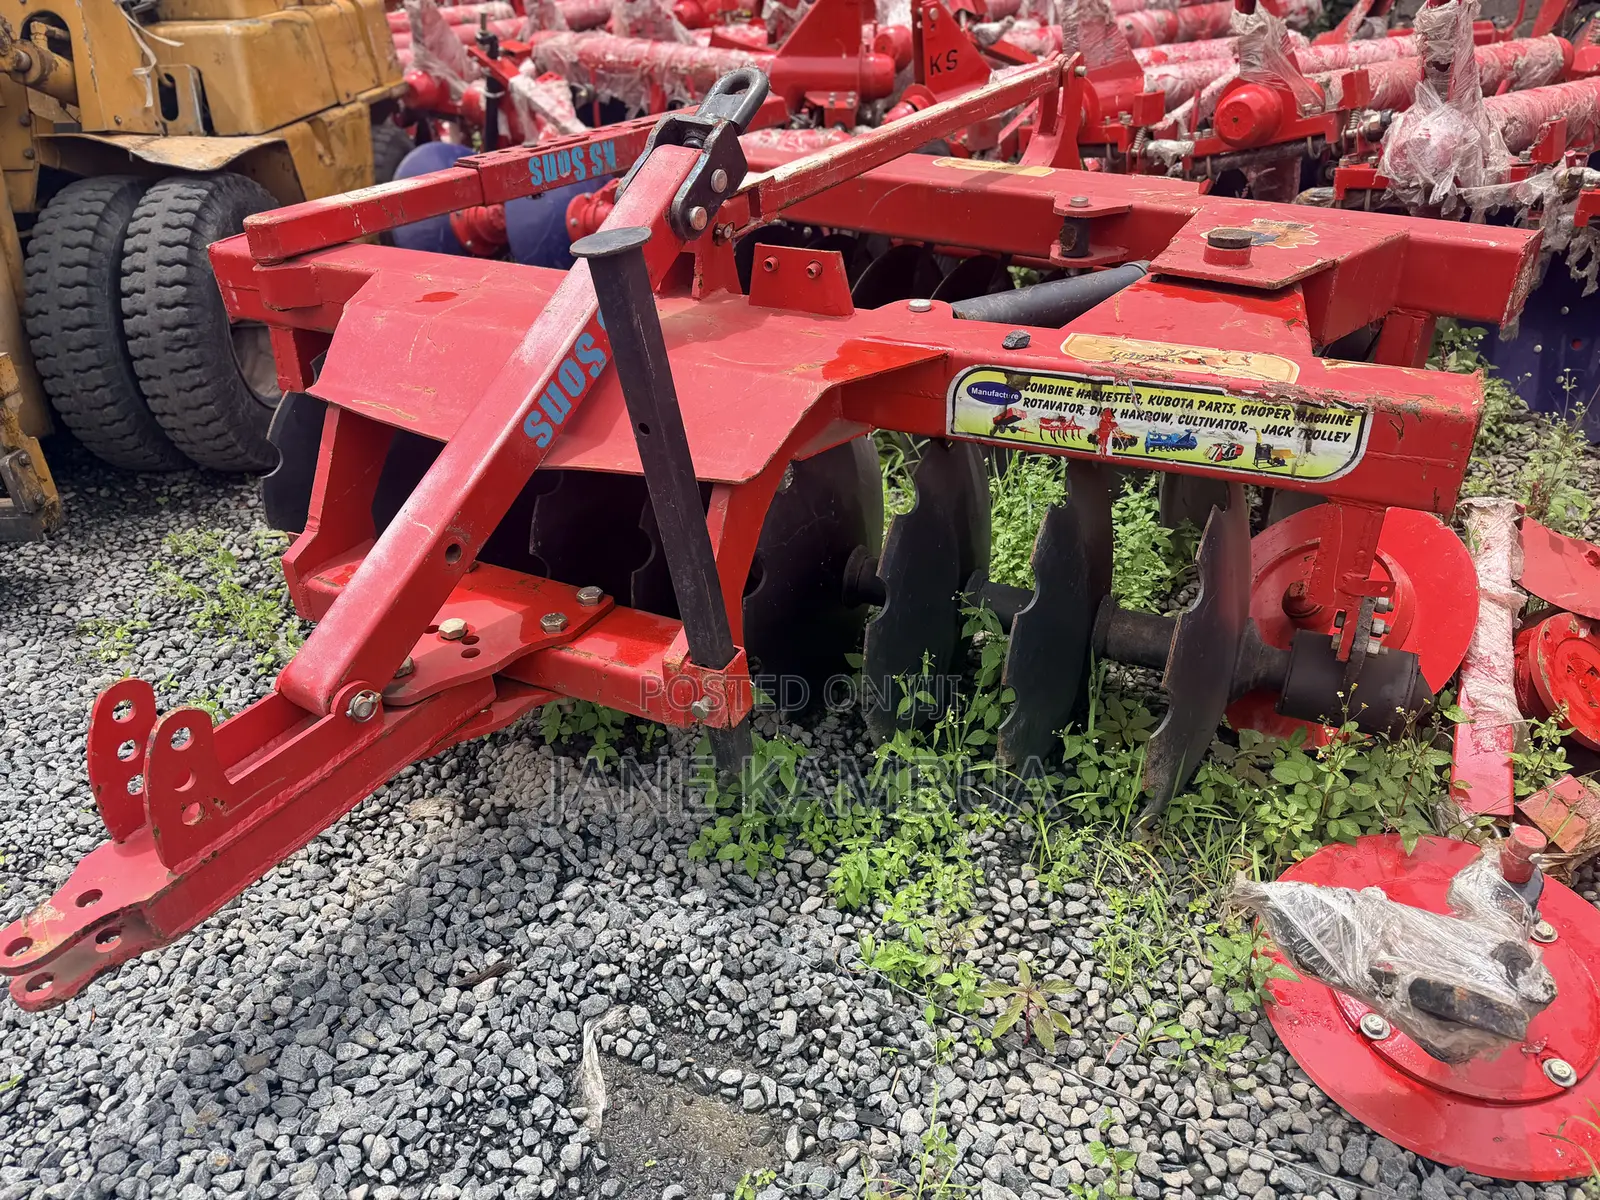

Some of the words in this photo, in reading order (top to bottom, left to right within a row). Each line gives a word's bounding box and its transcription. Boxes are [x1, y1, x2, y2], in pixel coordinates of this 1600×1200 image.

[930, 49, 957, 76] KS
[971, 387, 1019, 400] Manufacture
[1024, 382, 1075, 398] COMBINE
[1076, 389, 1144, 406] HARVESTER,
[1148, 395, 1195, 411] KUBOTA
[1197, 400, 1237, 417] PARTS,
[1241, 405, 1292, 421] CHOPER
[1293, 411, 1355, 427] MACHINE
[1023, 397, 1086, 417] ROTAVATOR,
[1178, 413, 1250, 434] CULTIVATOR,
[1261, 424, 1295, 438] JACK
[1297, 428, 1352, 443] TROLLEY
